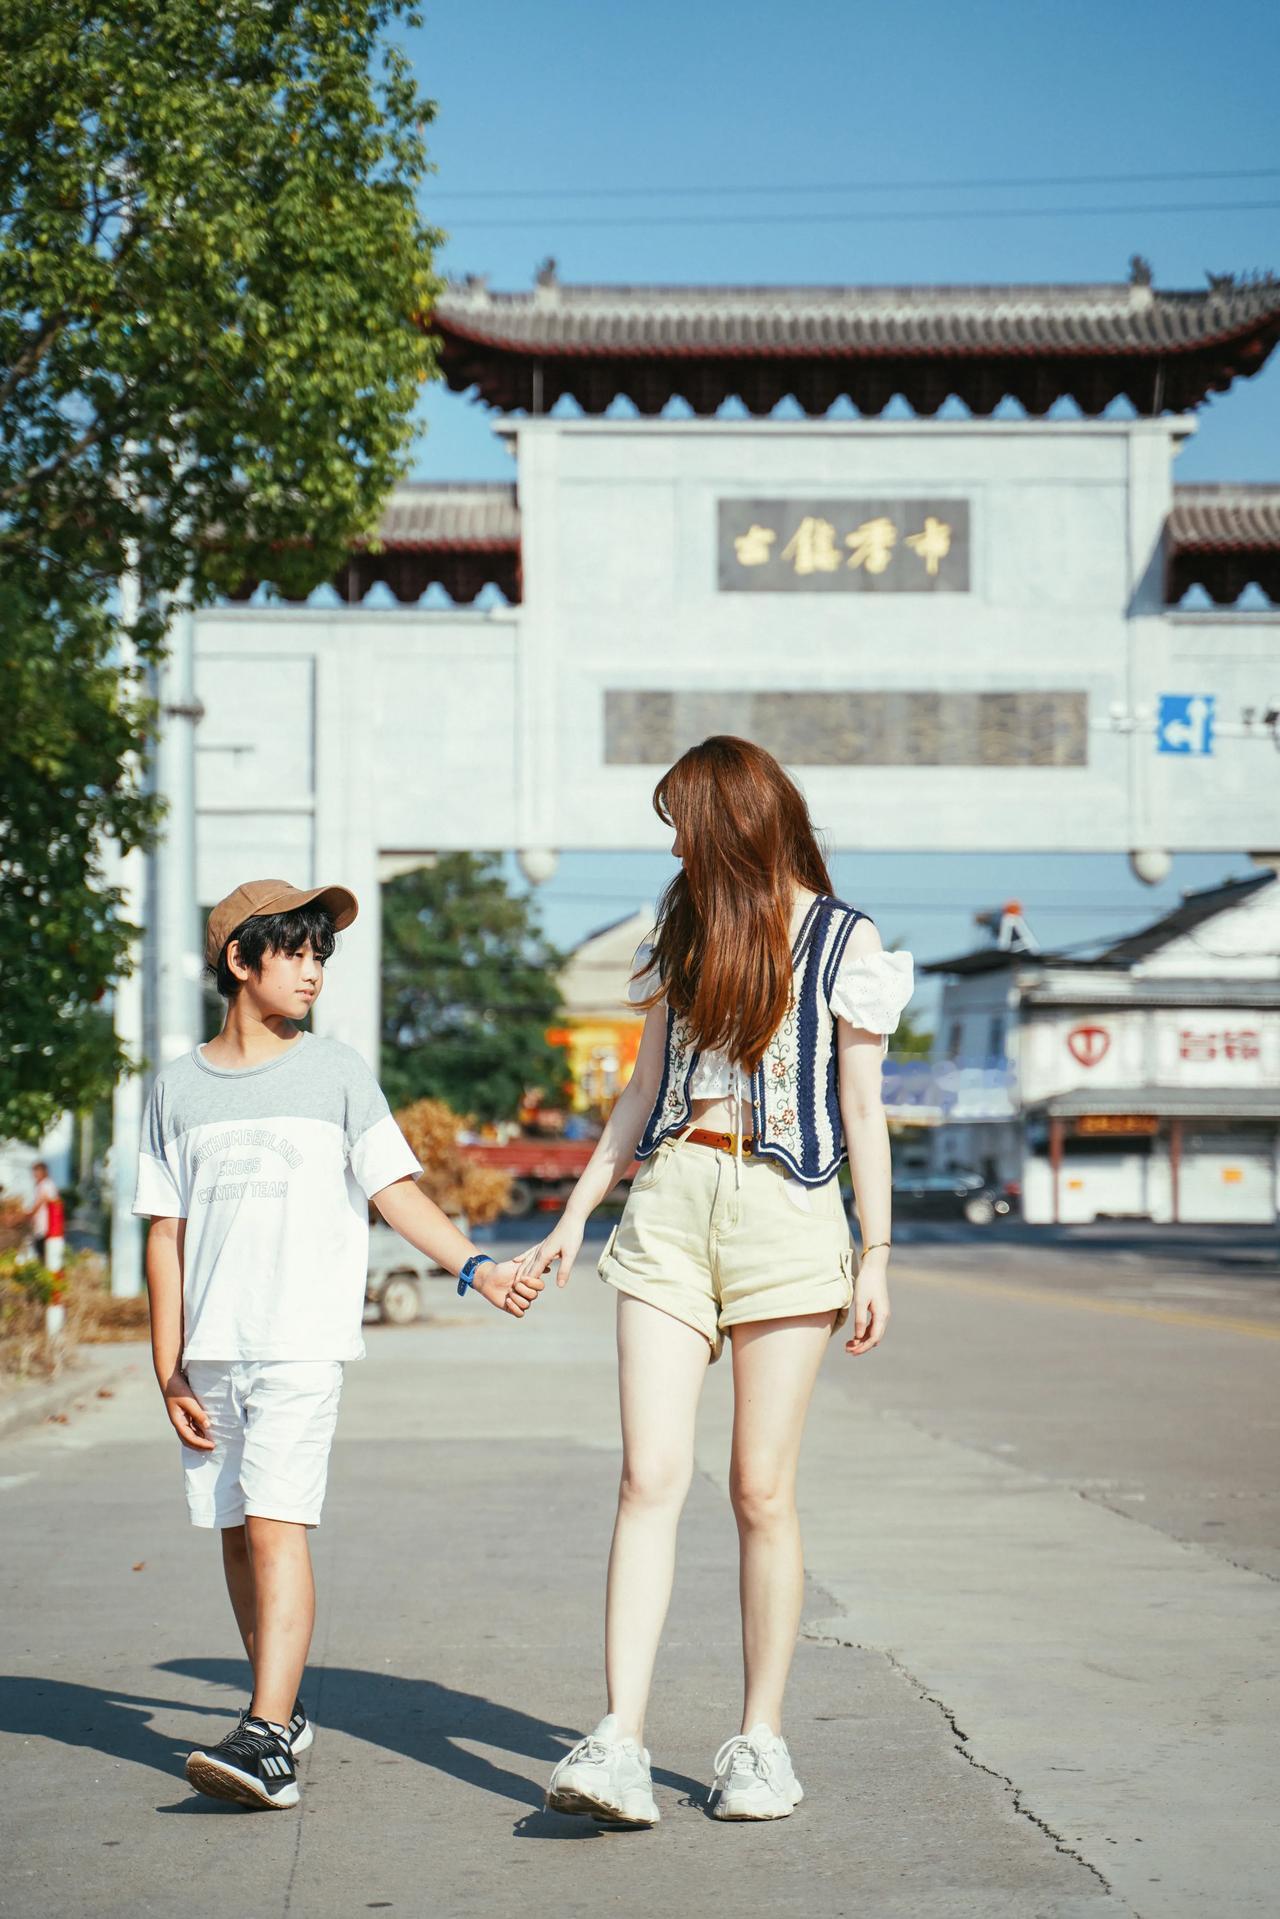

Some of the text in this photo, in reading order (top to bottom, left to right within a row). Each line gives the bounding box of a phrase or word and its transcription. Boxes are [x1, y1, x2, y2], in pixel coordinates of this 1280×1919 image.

[218, 1157, 261, 1176] CROSS
[197, 1181, 289, 1205] CONTRY TEAM
